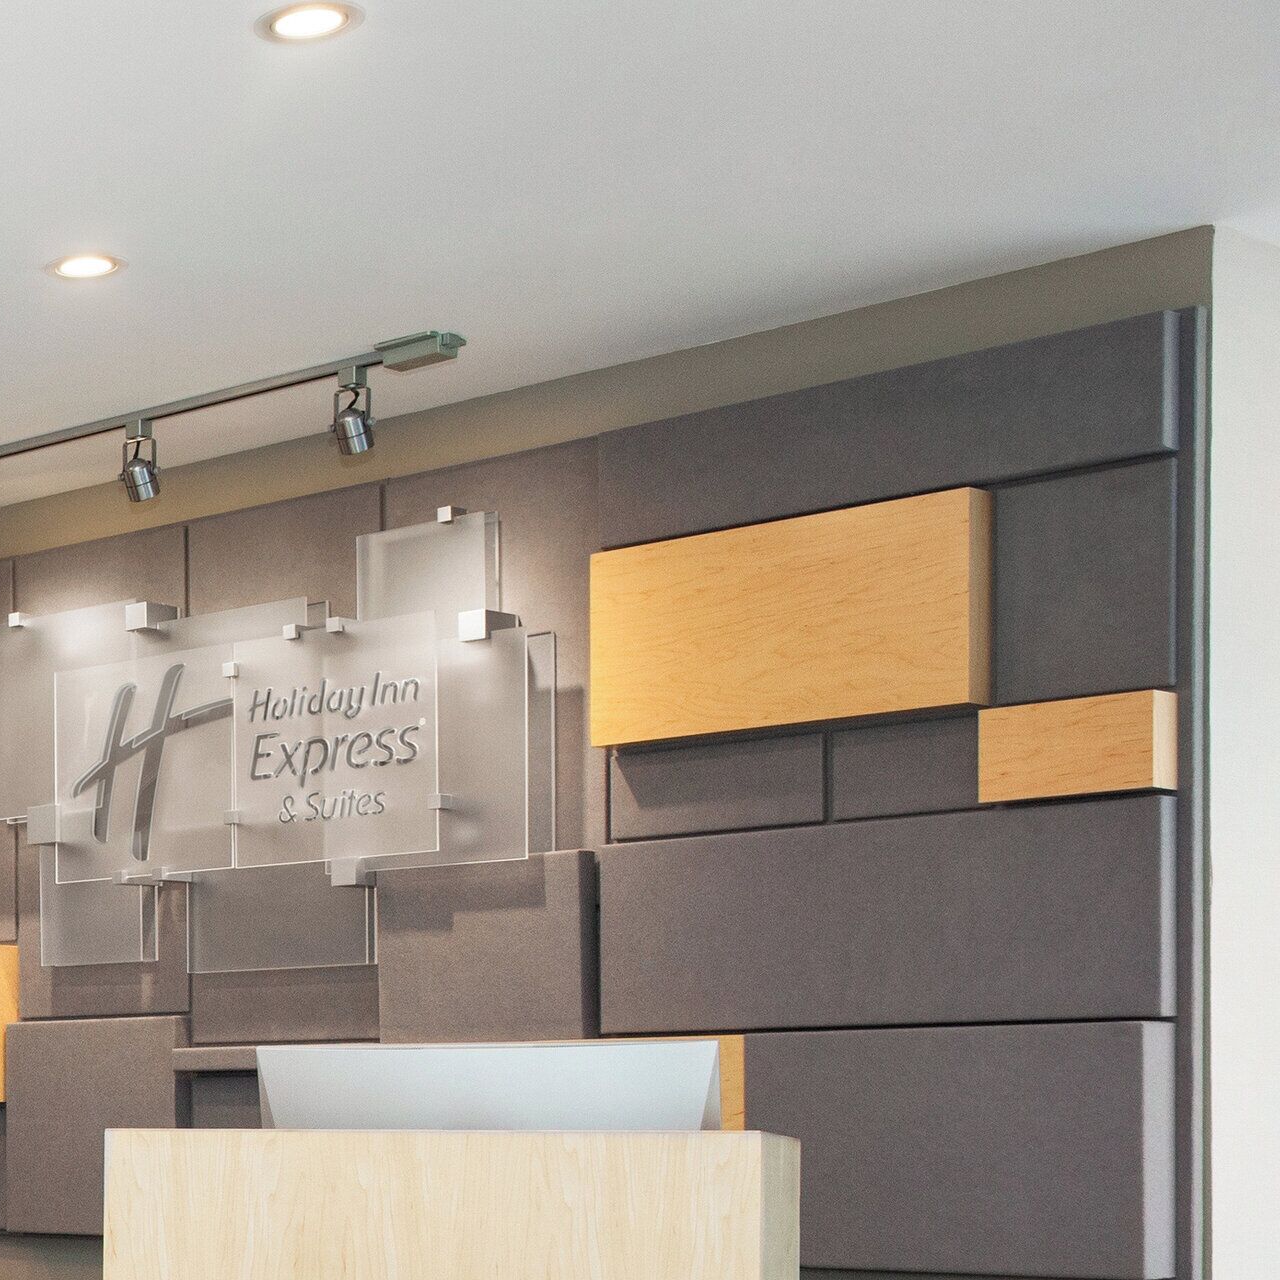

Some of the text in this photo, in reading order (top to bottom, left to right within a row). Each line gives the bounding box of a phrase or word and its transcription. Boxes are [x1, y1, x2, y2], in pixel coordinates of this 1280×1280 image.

[250, 724, 420, 788] Express
[278, 789, 386, 824] & Suites
